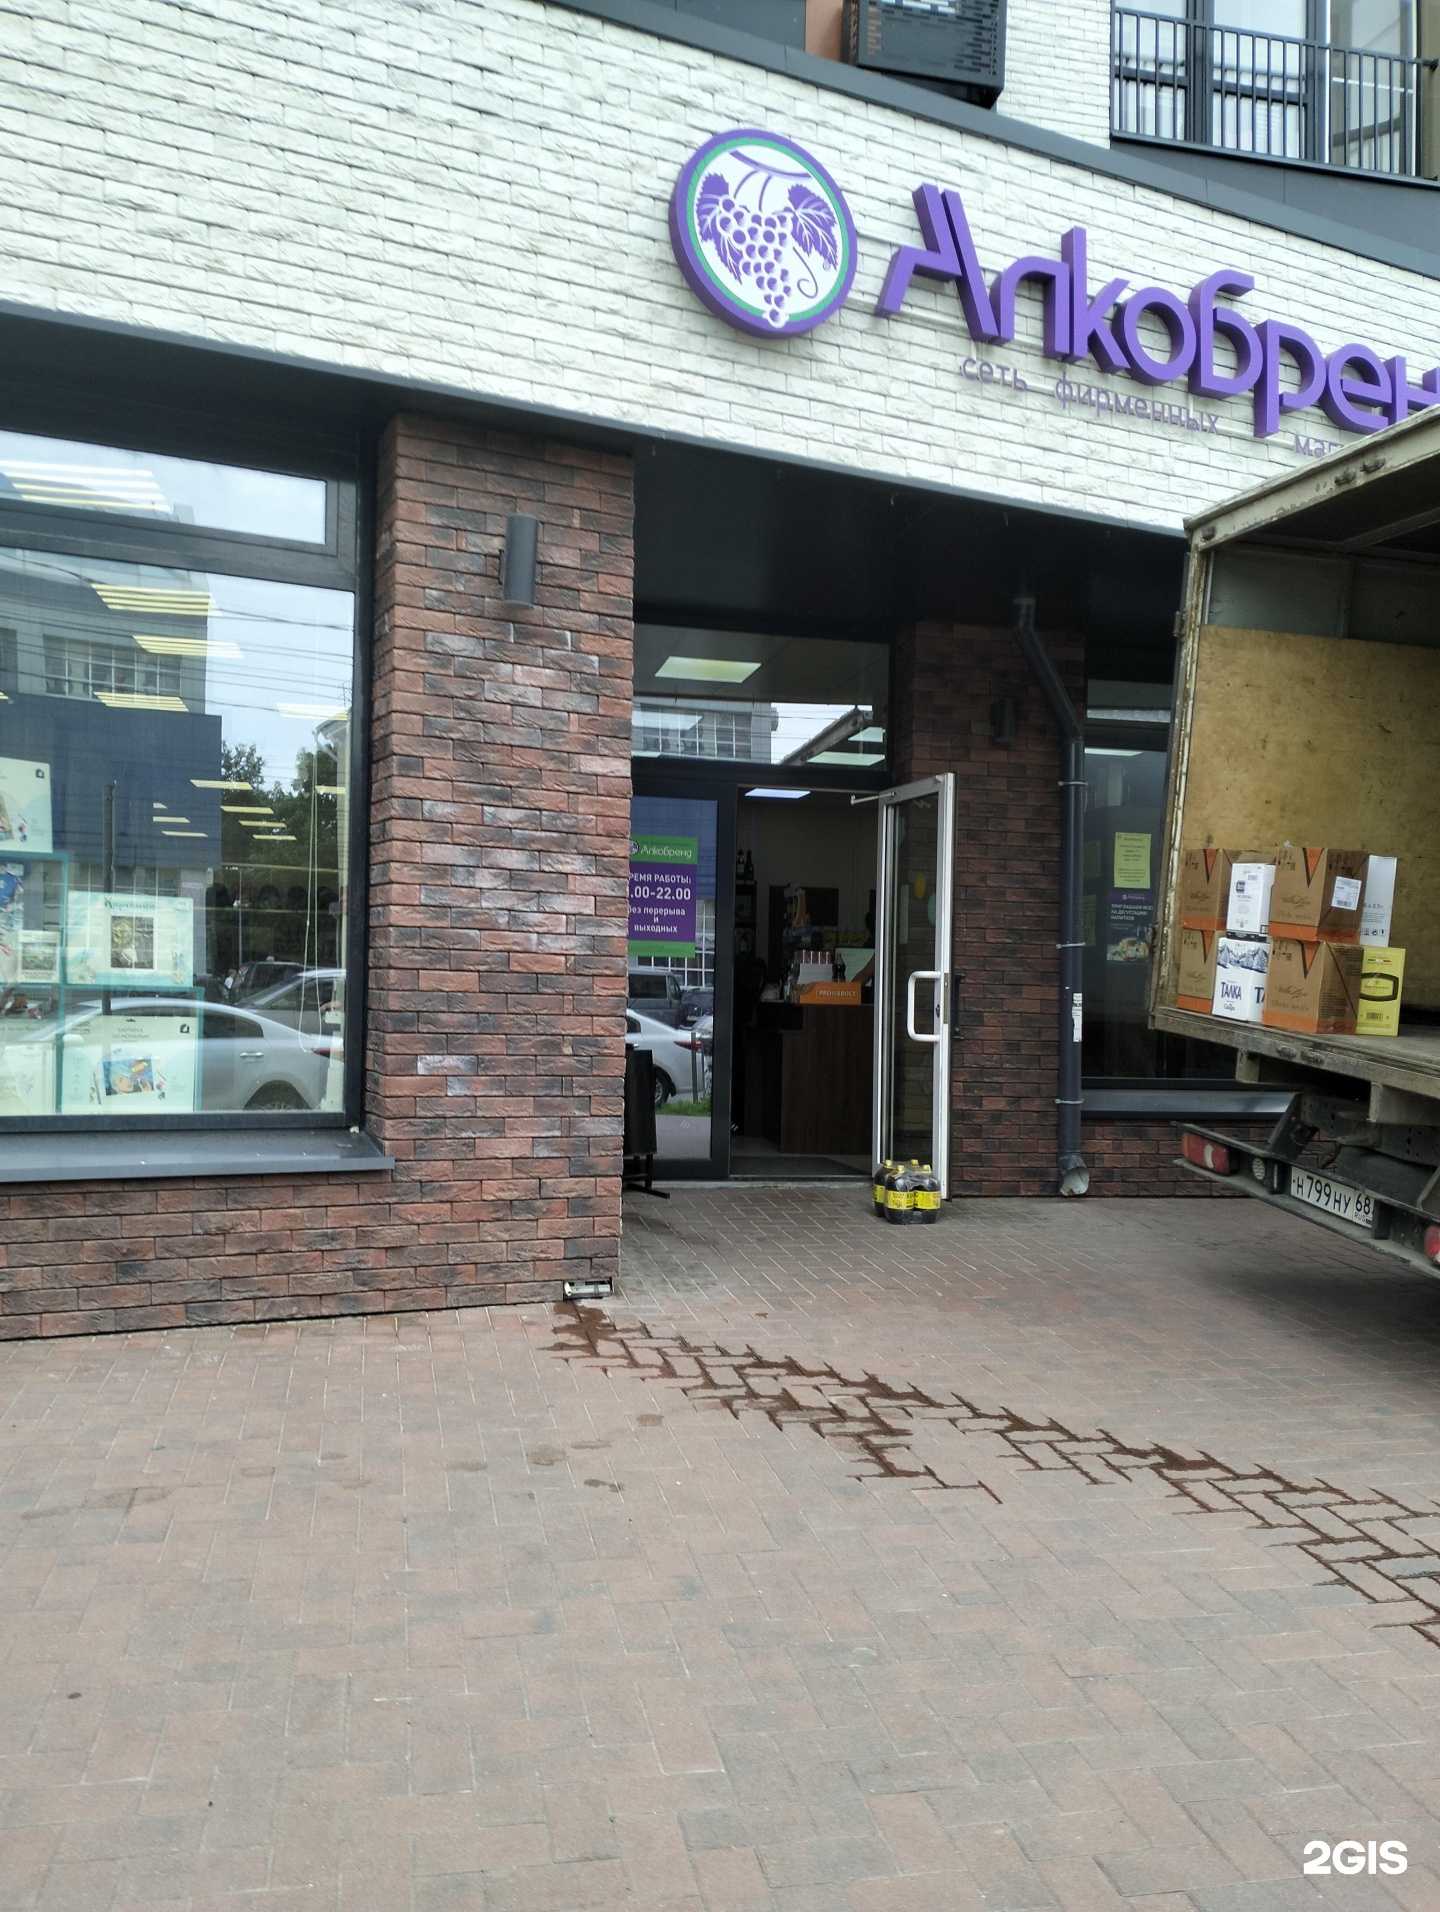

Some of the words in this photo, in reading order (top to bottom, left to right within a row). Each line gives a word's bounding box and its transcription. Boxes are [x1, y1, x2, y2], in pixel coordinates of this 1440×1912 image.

[960, 357, 1028, 391] сеть
[1055, 370, 1219, 434] фирменных
[644, 906, 685, 917] перерыва
[634, 924, 678, 934] выходных
